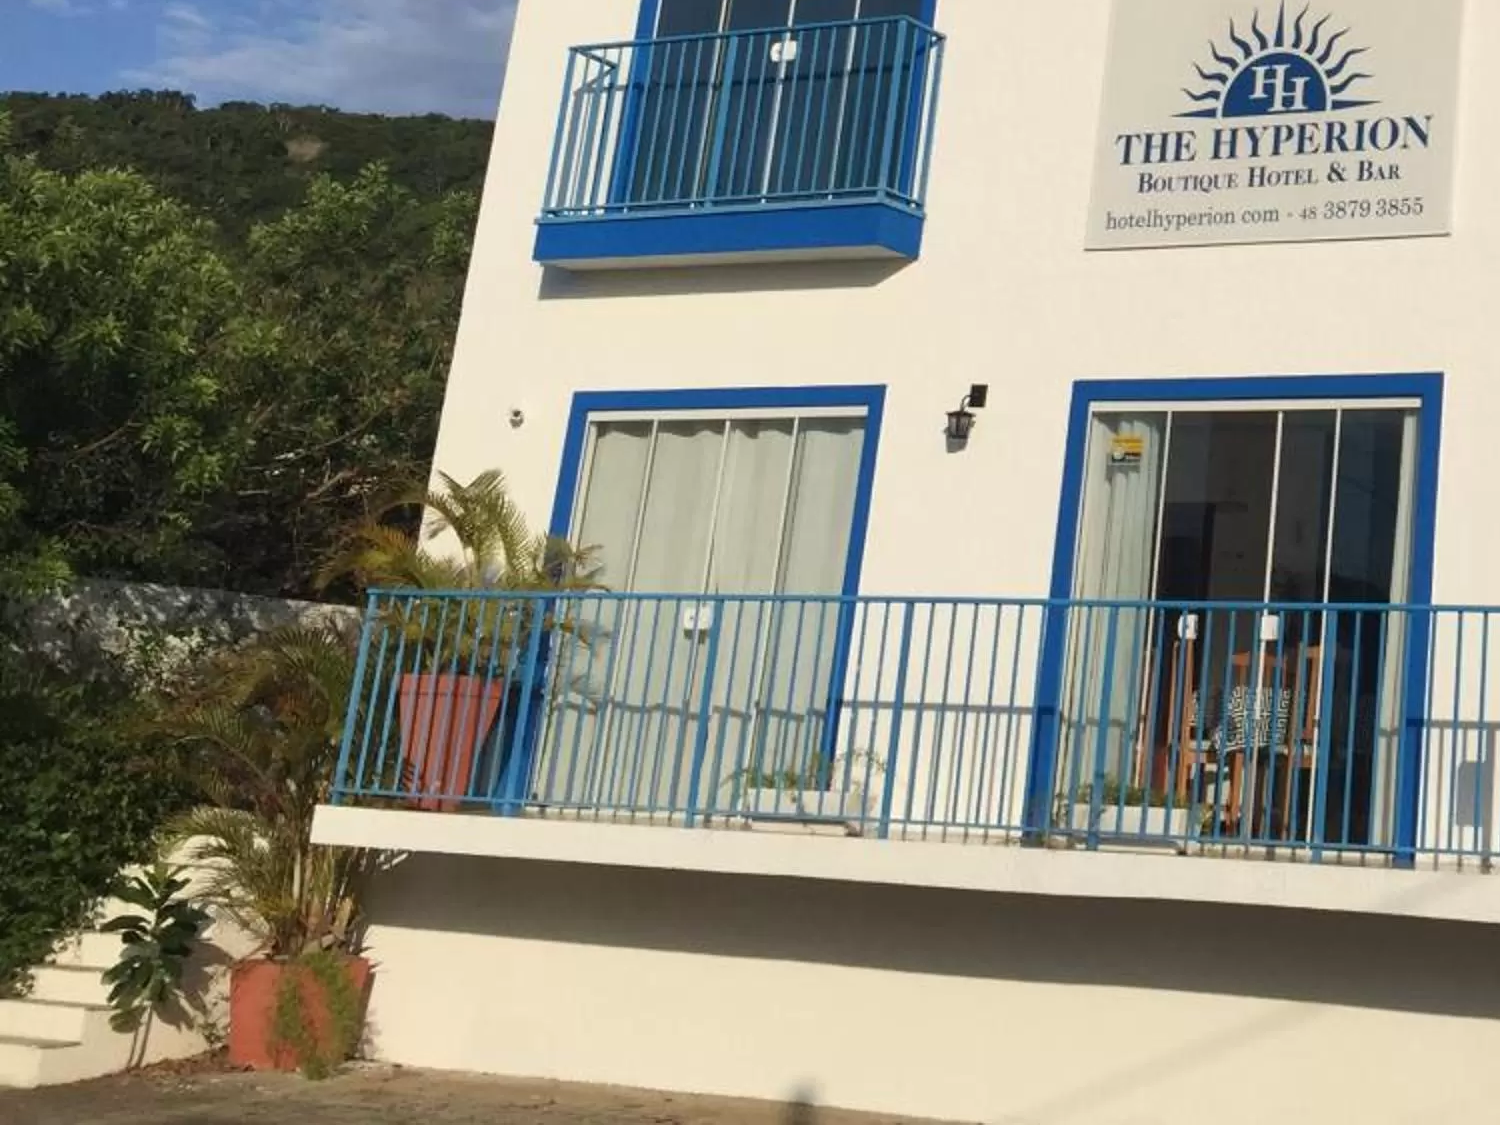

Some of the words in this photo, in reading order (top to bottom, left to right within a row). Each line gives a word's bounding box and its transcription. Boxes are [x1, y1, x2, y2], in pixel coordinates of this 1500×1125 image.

[1114, 129, 1198, 166] THE
[1209, 114, 1434, 161] HYPERION
[1137, 171, 1240, 194] BOUTIQUE
[1247, 165, 1319, 189] HOTEL
[1327, 160, 1347, 183] &
[1356, 159, 1402, 182] BAR
[1299, 205, 1317, 221] 48
[1323, 199, 1371, 220] 3879
[1374, 195, 1425, 218] 3855
